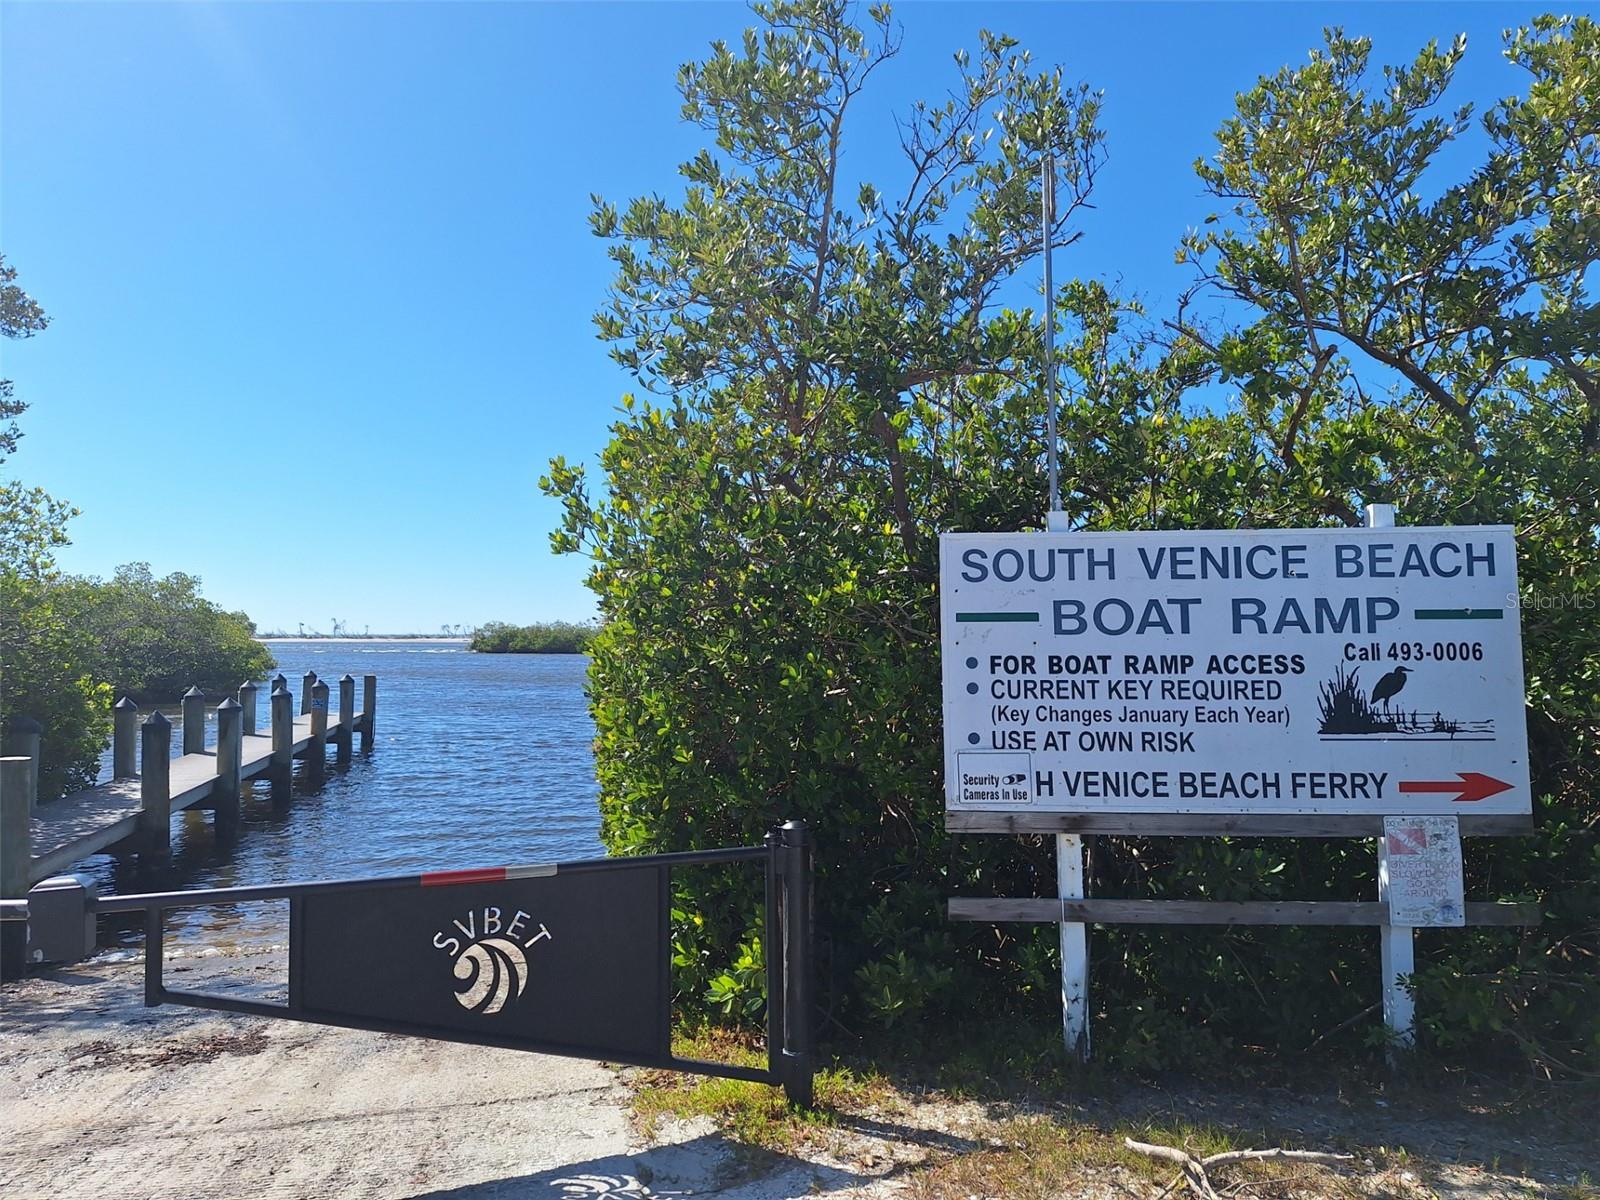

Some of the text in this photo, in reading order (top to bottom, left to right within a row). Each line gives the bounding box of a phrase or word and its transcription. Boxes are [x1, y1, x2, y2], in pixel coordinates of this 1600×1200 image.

[961, 542, 1496, 582] SOUTH VENICE BEACH
[1052, 597, 1400, 636] BOAT RAMP
[1343, 641, 1483, 662] Call 493-0006
[989, 654, 1305, 675] FOR BOAT RAMP ACCESS
[990, 679, 1282, 701] CURRENT KEY REQUIRED
[991, 705, 1290, 728] (Key Changes January Each Year)
[991, 730, 1196, 753] USE AT OWN RISK
[963, 773, 1000, 788] Security
[1062, 771, 1169, 798] VENICE
[1179, 772, 1281, 799] BEACH
[1291, 772, 1388, 799] FERRY
[963, 788, 1028, 801] Cameras In Use
[432, 907, 552, 957] SVBET
